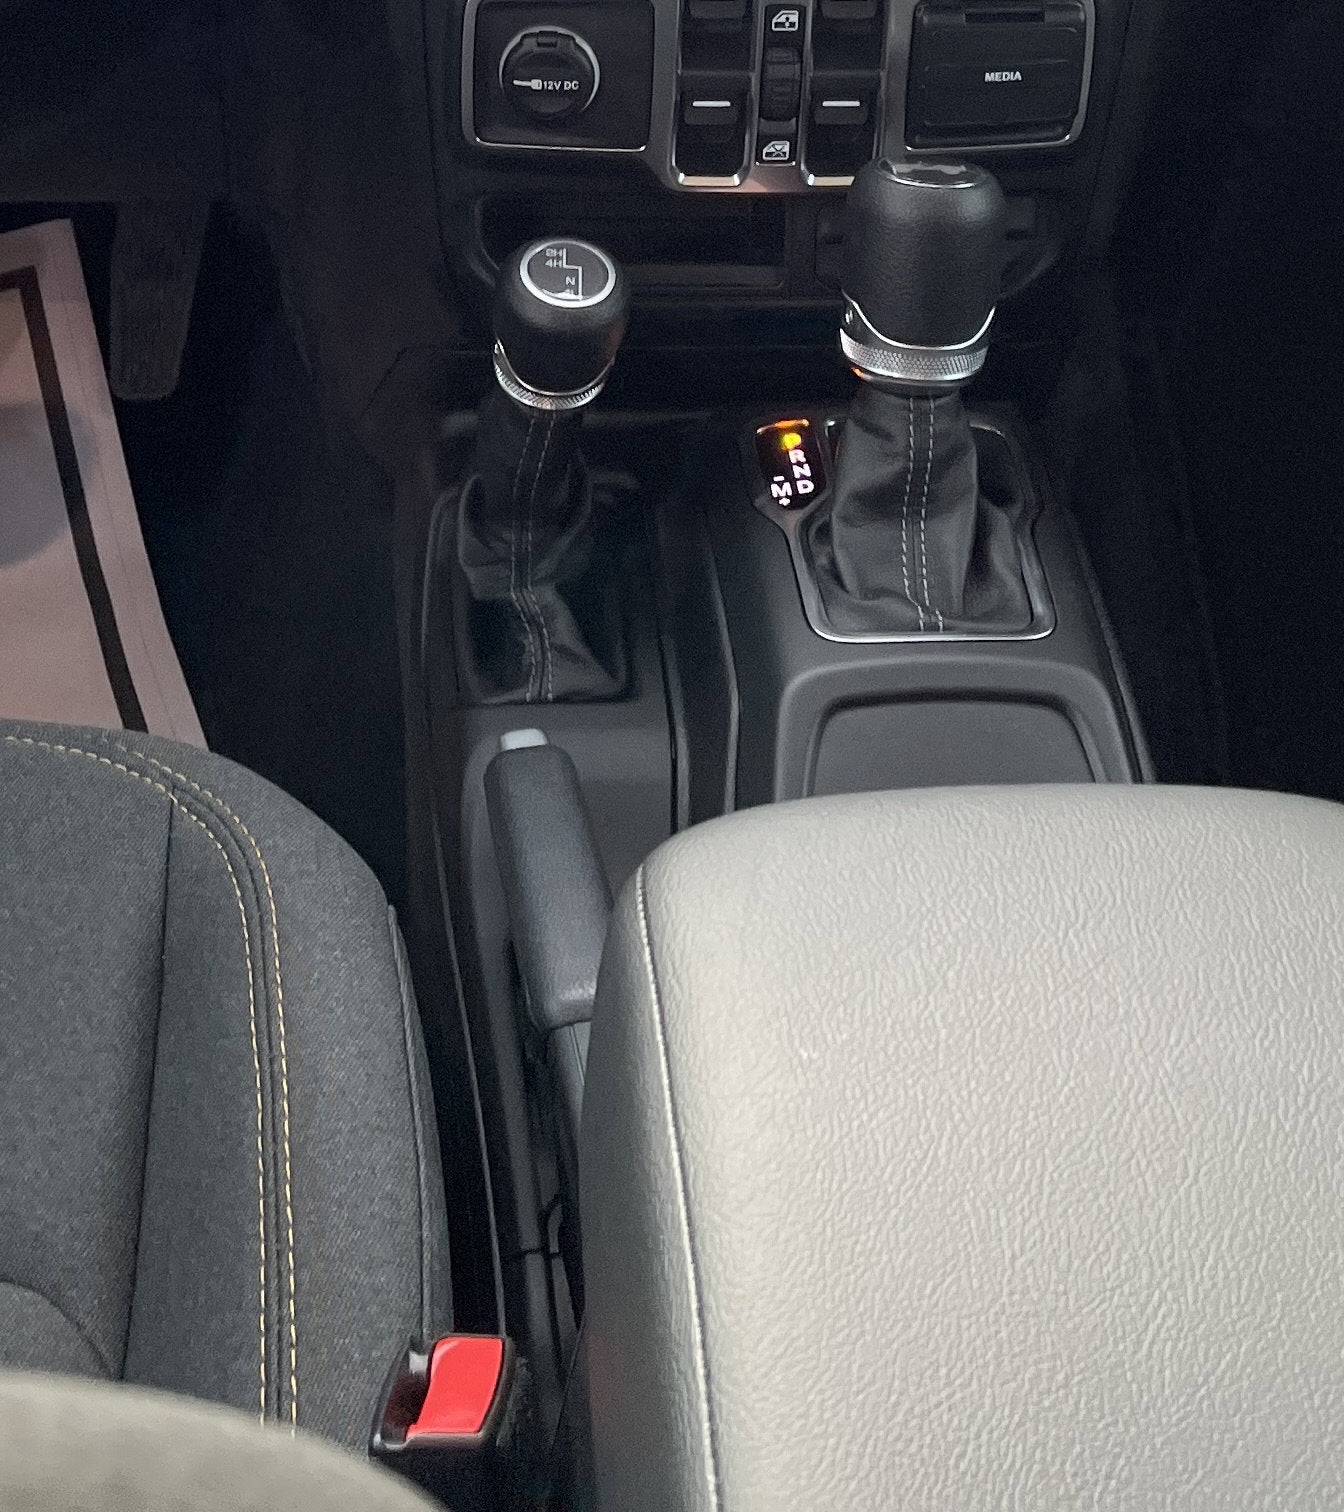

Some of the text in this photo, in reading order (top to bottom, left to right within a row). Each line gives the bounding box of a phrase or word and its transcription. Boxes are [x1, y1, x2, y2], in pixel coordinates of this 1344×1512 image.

[984, 70, 1022, 83] MEDIA
[542, 79, 579, 91] 12V DC
[544, 258, 563, 268] 4H
[565, 275, 576, 286] N
[788, 449, 806, 464] R
[792, 463, 812, 479] N
[770, 481, 793, 498] M
[796, 479, 815, 495] D
